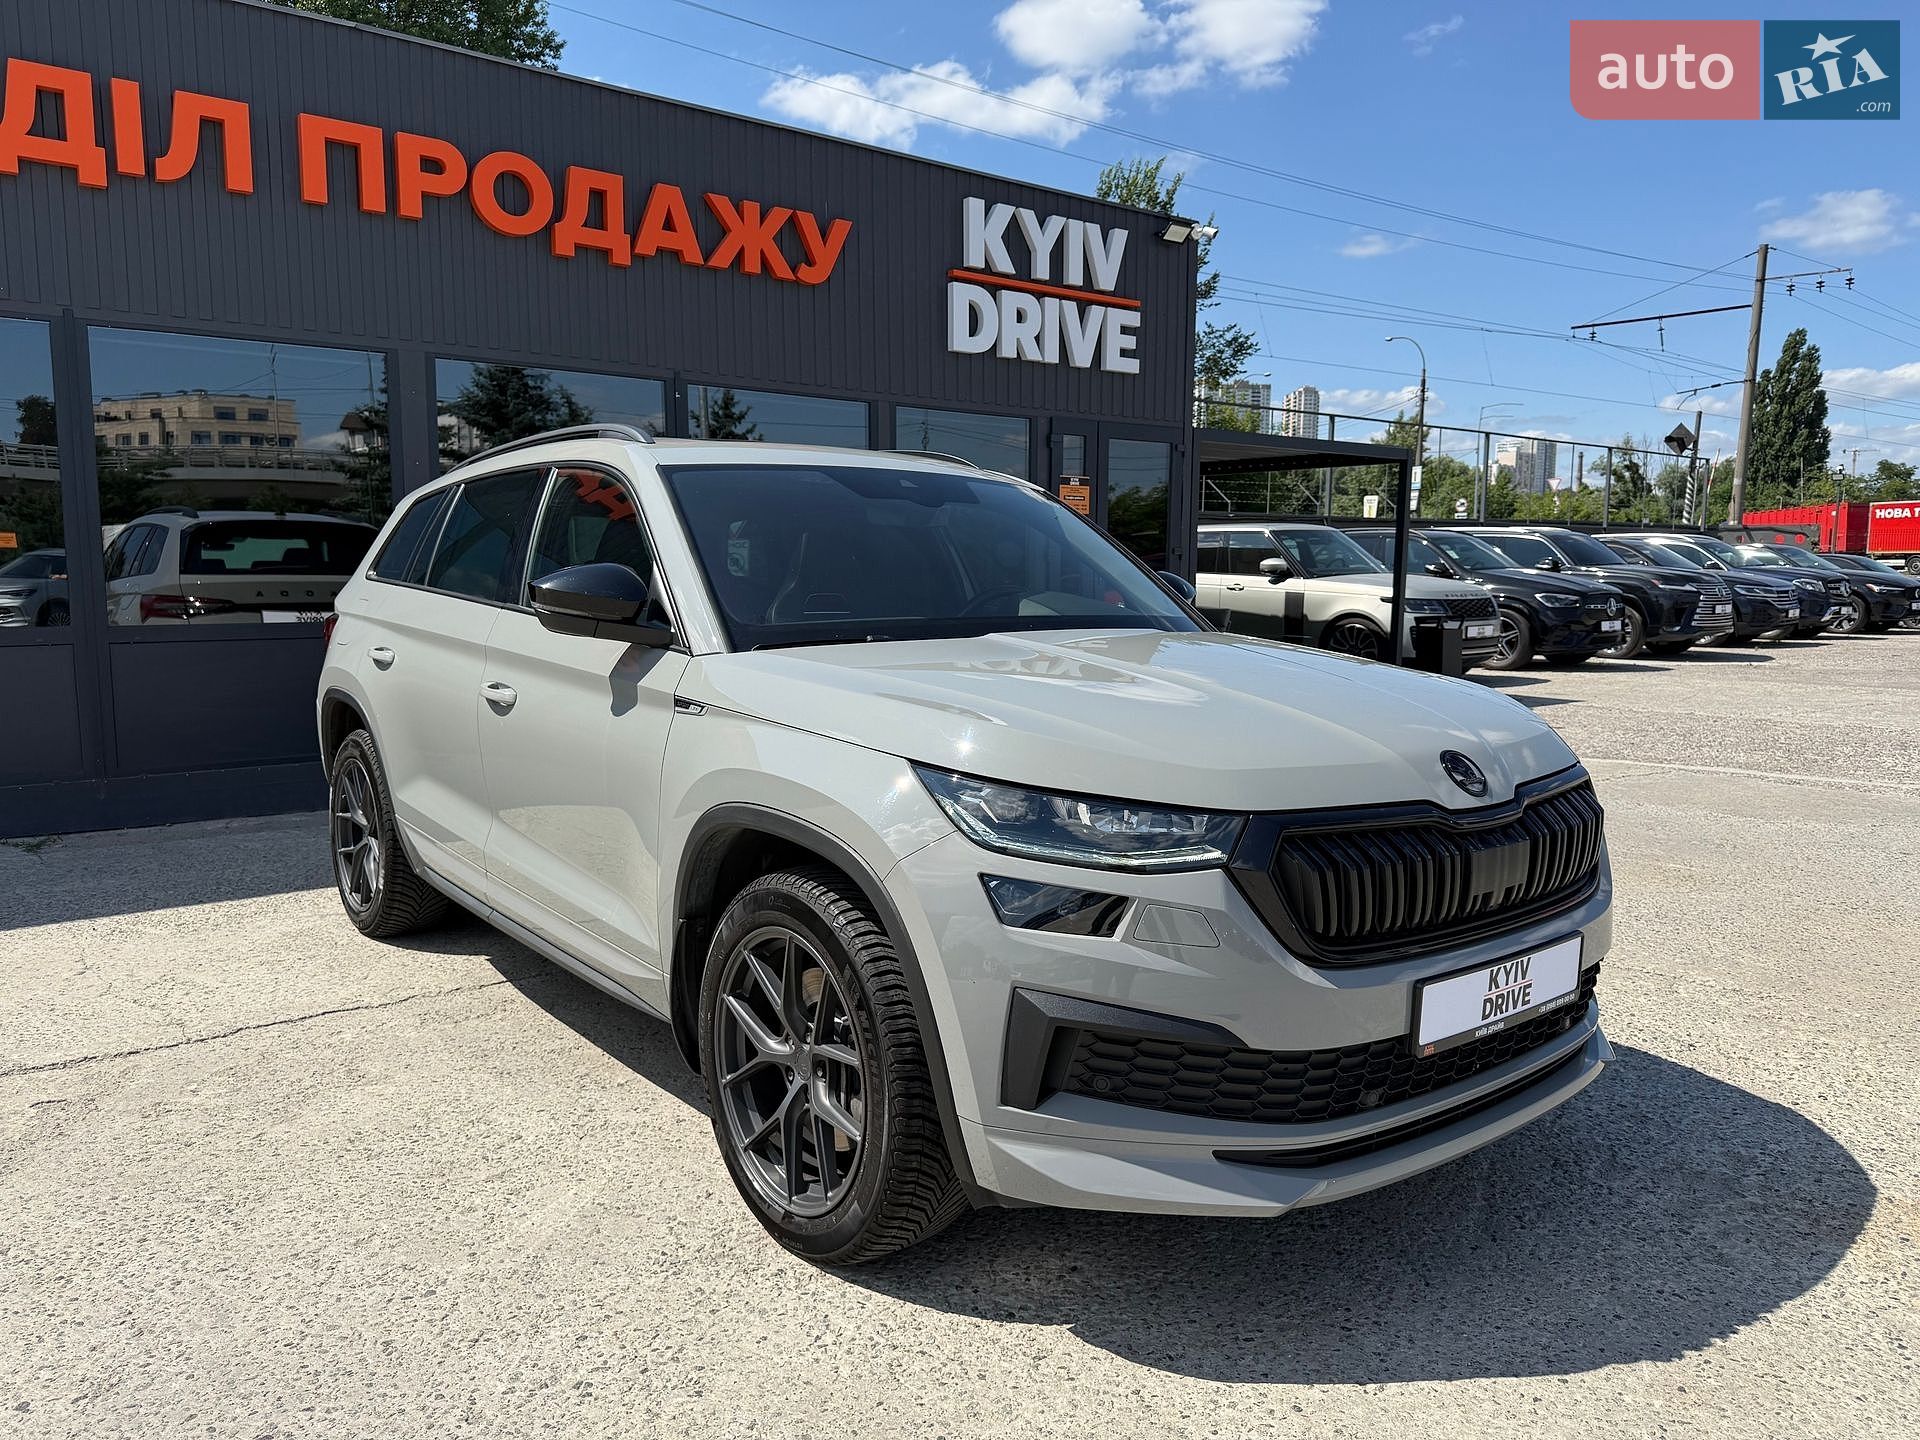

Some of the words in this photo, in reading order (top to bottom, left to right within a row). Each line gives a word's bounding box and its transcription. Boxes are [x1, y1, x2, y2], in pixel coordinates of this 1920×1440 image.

[0, 57, 254, 195] ДІЛ
[297, 112, 854, 286] ПРОДАЖУ
[962, 196, 1129, 292] KYIV
[947, 281, 1141, 374] DRIVE
[1875, 507, 1912, 519] НОВА
[1481, 982, 1532, 1021] DRIVE
[1488, 956, 1532, 992] KYIV
